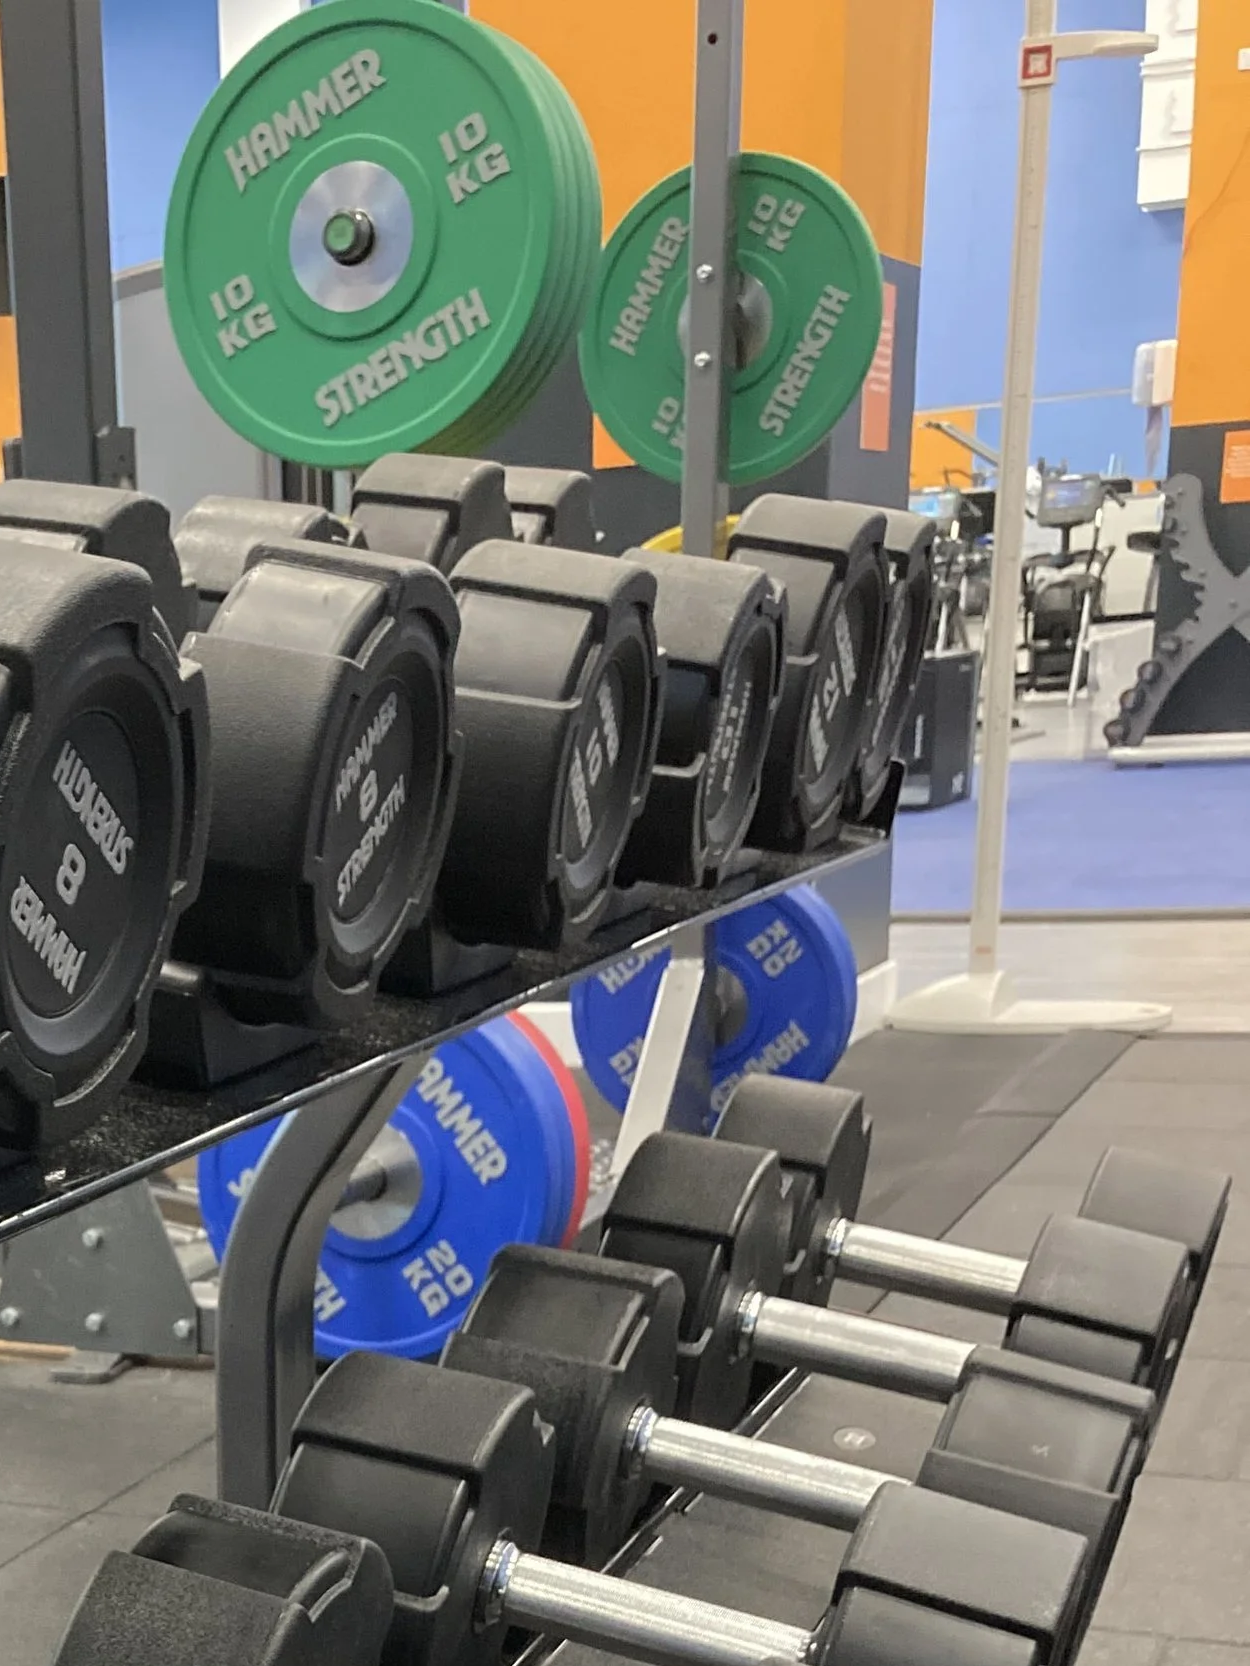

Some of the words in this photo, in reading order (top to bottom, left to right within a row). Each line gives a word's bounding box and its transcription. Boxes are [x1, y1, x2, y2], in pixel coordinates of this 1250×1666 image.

[224, 49, 388, 192] HAMMER
[438, 111, 490, 165] 10
[446, 142, 511, 205] KG
[747, 193, 779, 235] 10
[766, 199, 806, 253] KG
[209, 273, 257, 322] 10
[608, 217, 691, 356] HAMMER
[216, 301, 278, 359] KG
[313, 287, 494, 429] STRENGTH
[759, 284, 852, 437] STRENGTH
[53, 740, 135, 875] STRENGTH
[56, 843, 86, 906] 8
[416, 1057, 507, 1186] AMMER
[402, 1257, 450, 1319] KG
[426, 1239, 473, 1298] 20
